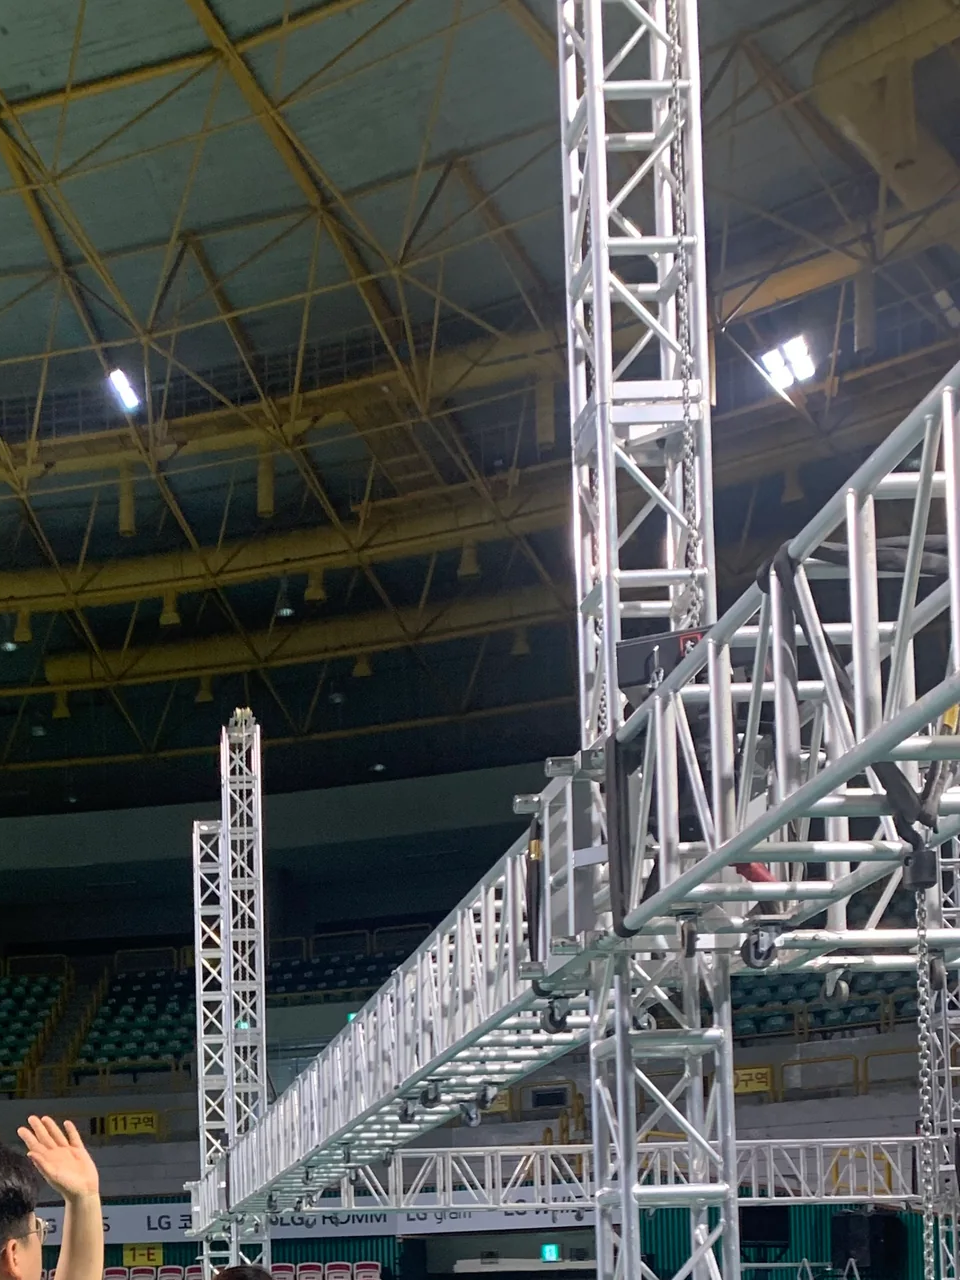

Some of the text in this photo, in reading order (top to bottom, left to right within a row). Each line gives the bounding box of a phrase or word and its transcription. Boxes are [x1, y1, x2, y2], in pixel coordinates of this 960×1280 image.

[111, 1115, 155, 1131] 11구역
[146, 1214, 172, 1232] LG
[129, 1246, 157, 1262] 1-E
